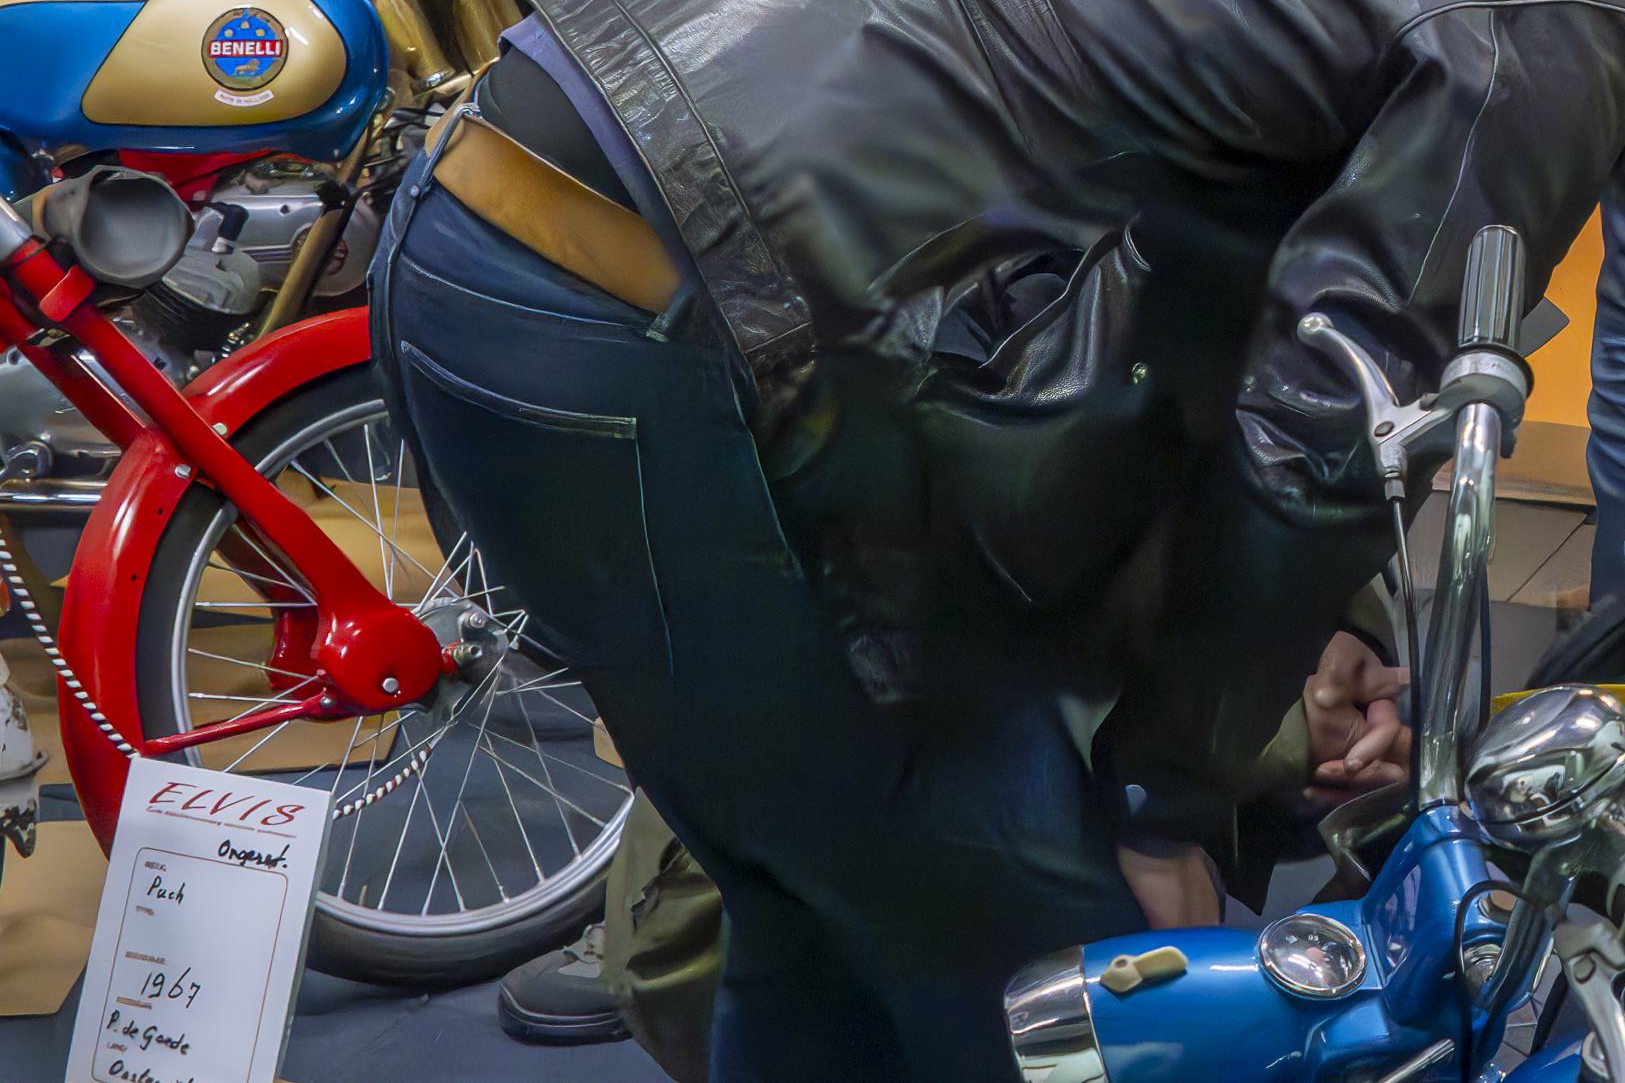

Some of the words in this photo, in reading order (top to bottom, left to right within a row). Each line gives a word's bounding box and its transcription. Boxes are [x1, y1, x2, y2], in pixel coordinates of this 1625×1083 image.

[210, 41, 281, 56] BENELLI
[148, 781, 306, 826] ELVIS
[146, 875, 186, 905] Puch
[140, 966, 201, 1009] 1967
[122, 1020, 139, 1039] de
